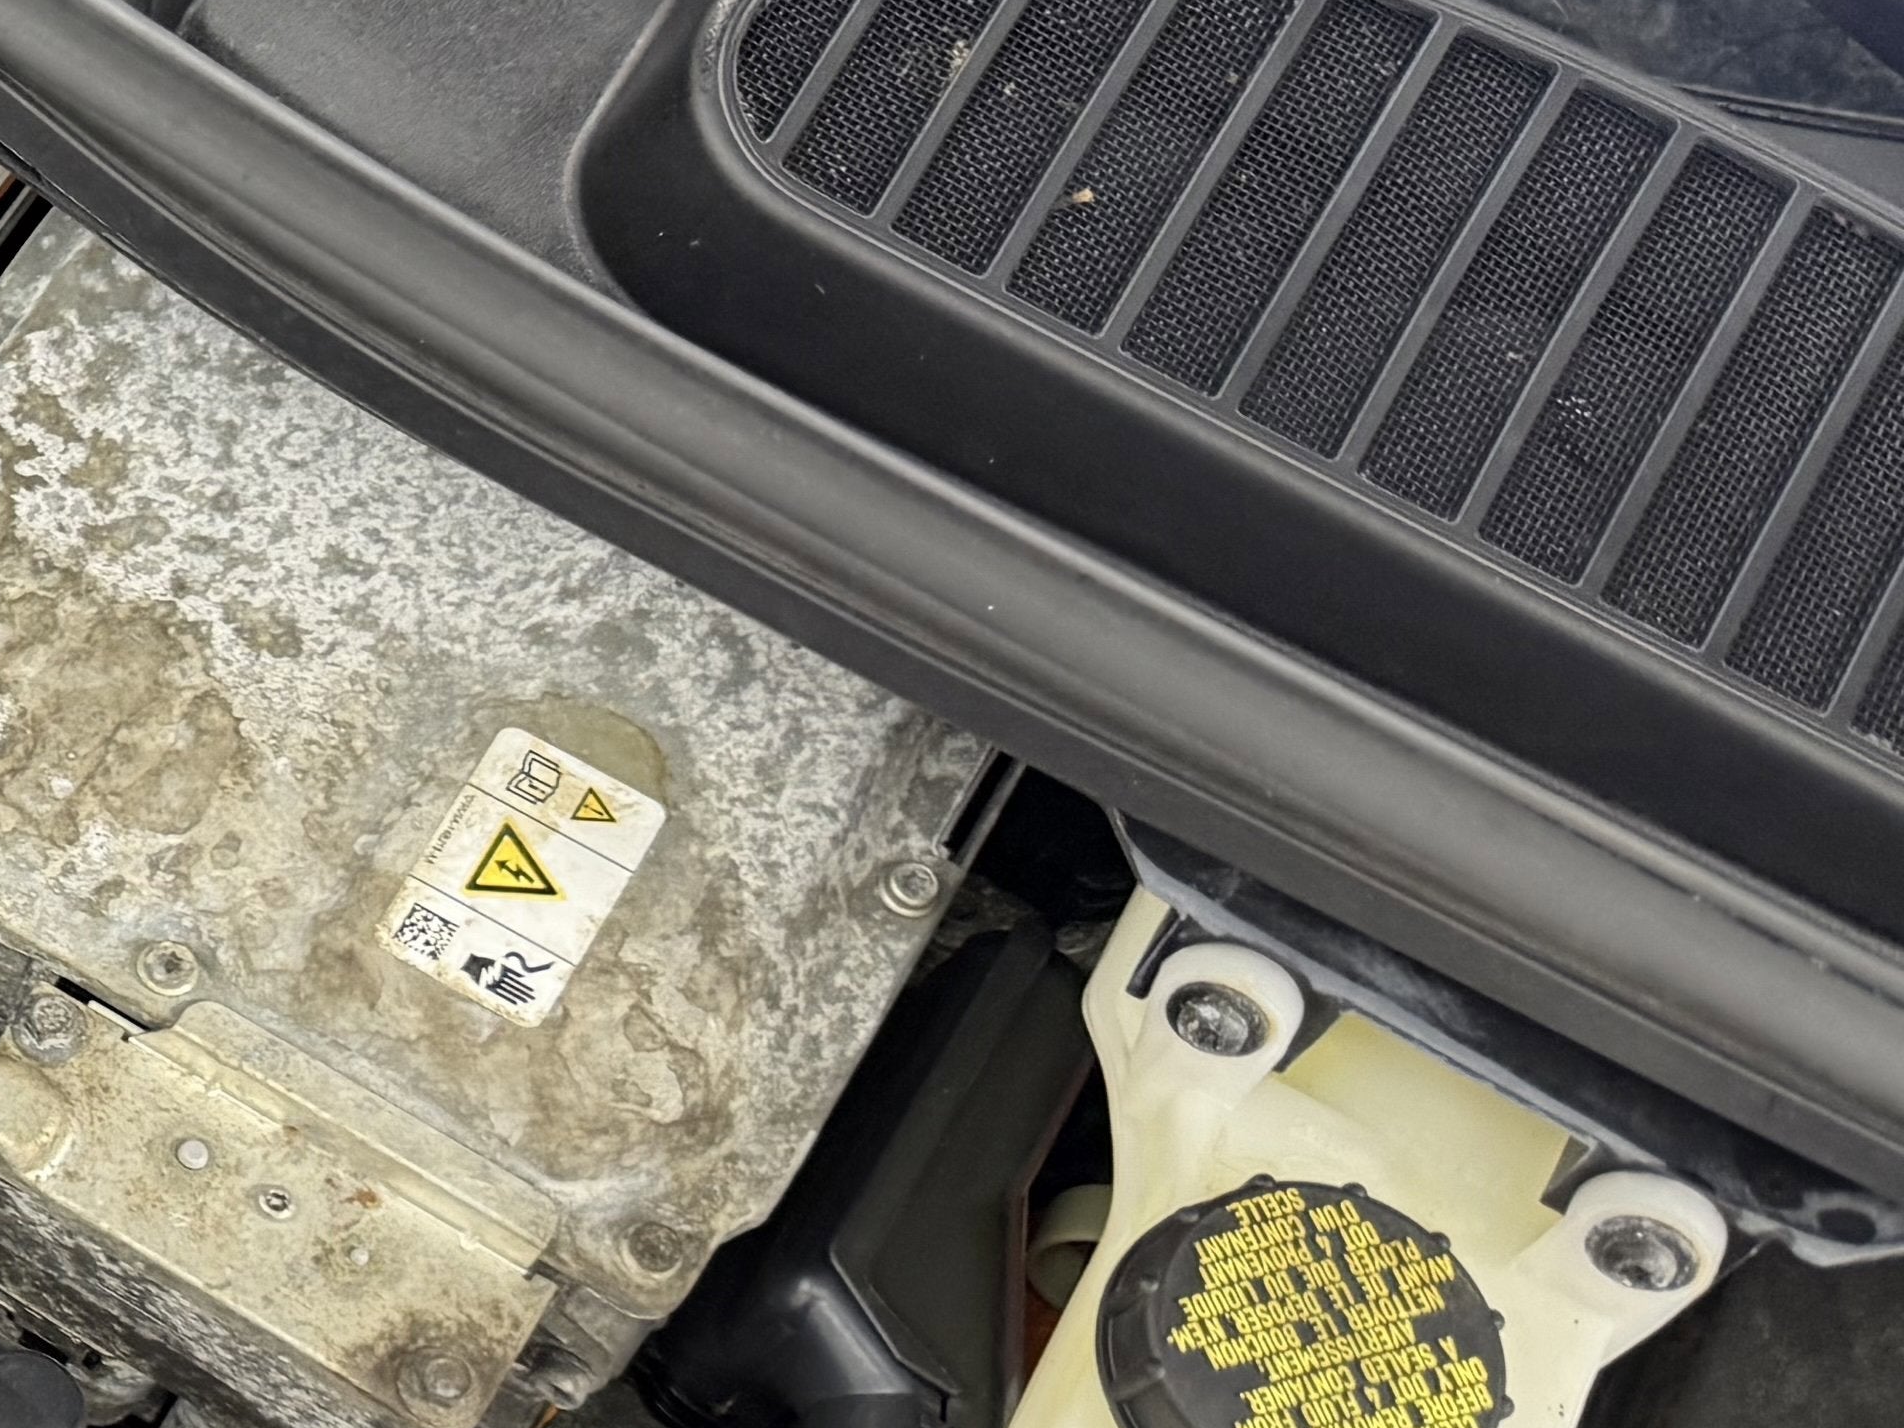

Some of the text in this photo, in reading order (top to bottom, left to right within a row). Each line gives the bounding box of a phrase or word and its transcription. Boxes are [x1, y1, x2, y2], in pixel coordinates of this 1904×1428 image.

[1194, 1213, 1306, 1266] CONTENANT
[1339, 1220, 1381, 1252] DOT
[1178, 1236, 1422, 1325] PLOYER QUE DU LIQUIDE
[1198, 1237, 1313, 1291] PROVENANT
[1392, 1253, 1455, 1294] AVANT
[1323, 1281, 1355, 1309] LE
[1355, 1271, 1389, 1301] DE
[1203, 1284, 1446, 1371] NETTOYER LE BOUCHON
[1360, 1342, 1438, 1384] SEALED
[1438, 1336, 1459, 1362] A
[1388, 1371, 1432, 1405] DOT
[1434, 1356, 1488, 1393] ONLY
[1300, 1390, 1362, 1428] FLUID
[1413, 1382, 1494, 1426] BEFORE
